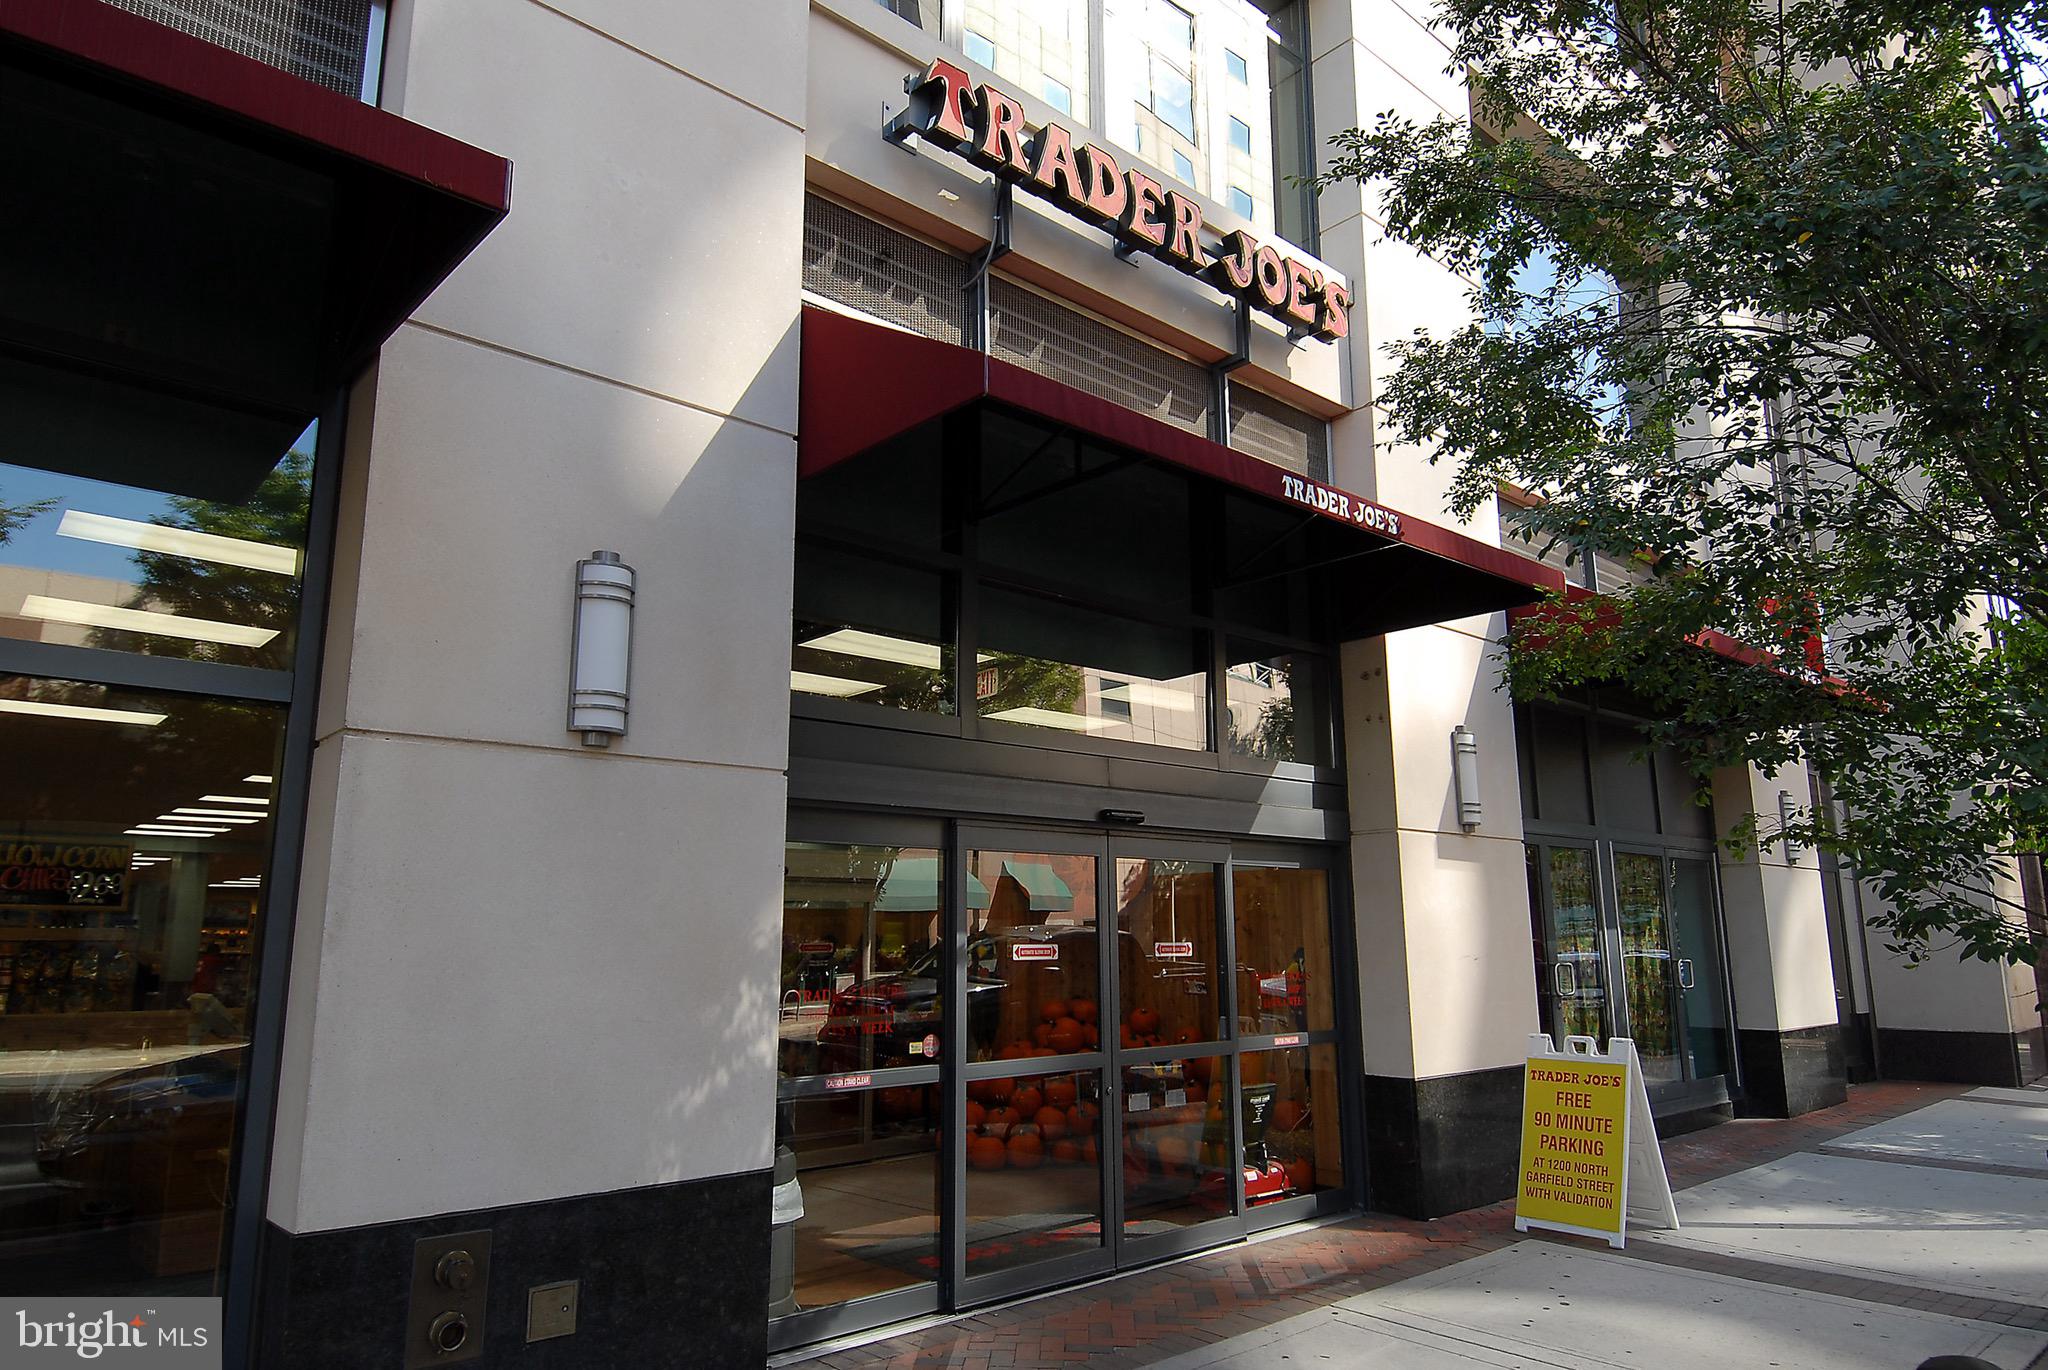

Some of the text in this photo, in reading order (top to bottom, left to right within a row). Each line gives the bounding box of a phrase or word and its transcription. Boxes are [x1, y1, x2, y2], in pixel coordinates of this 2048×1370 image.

[918, 57, 1352, 340] TRADER JOE'S
[1282, 474, 1399, 535] TRADER JOE'S
[1530, 1069, 1621, 1088] TRADER JOE'S
[1556, 1091, 1592, 1109] FREE
[1534, 1111, 1613, 1134] 90 MINUTE
[1540, 1134, 1604, 1156] PARKING
[1533, 1157, 1609, 1176] AT 1200 NORTH
[1526, 1171, 1615, 1194] GARFIELD STREET
[1525, 1186, 1613, 1210] WITH VALIDATION
